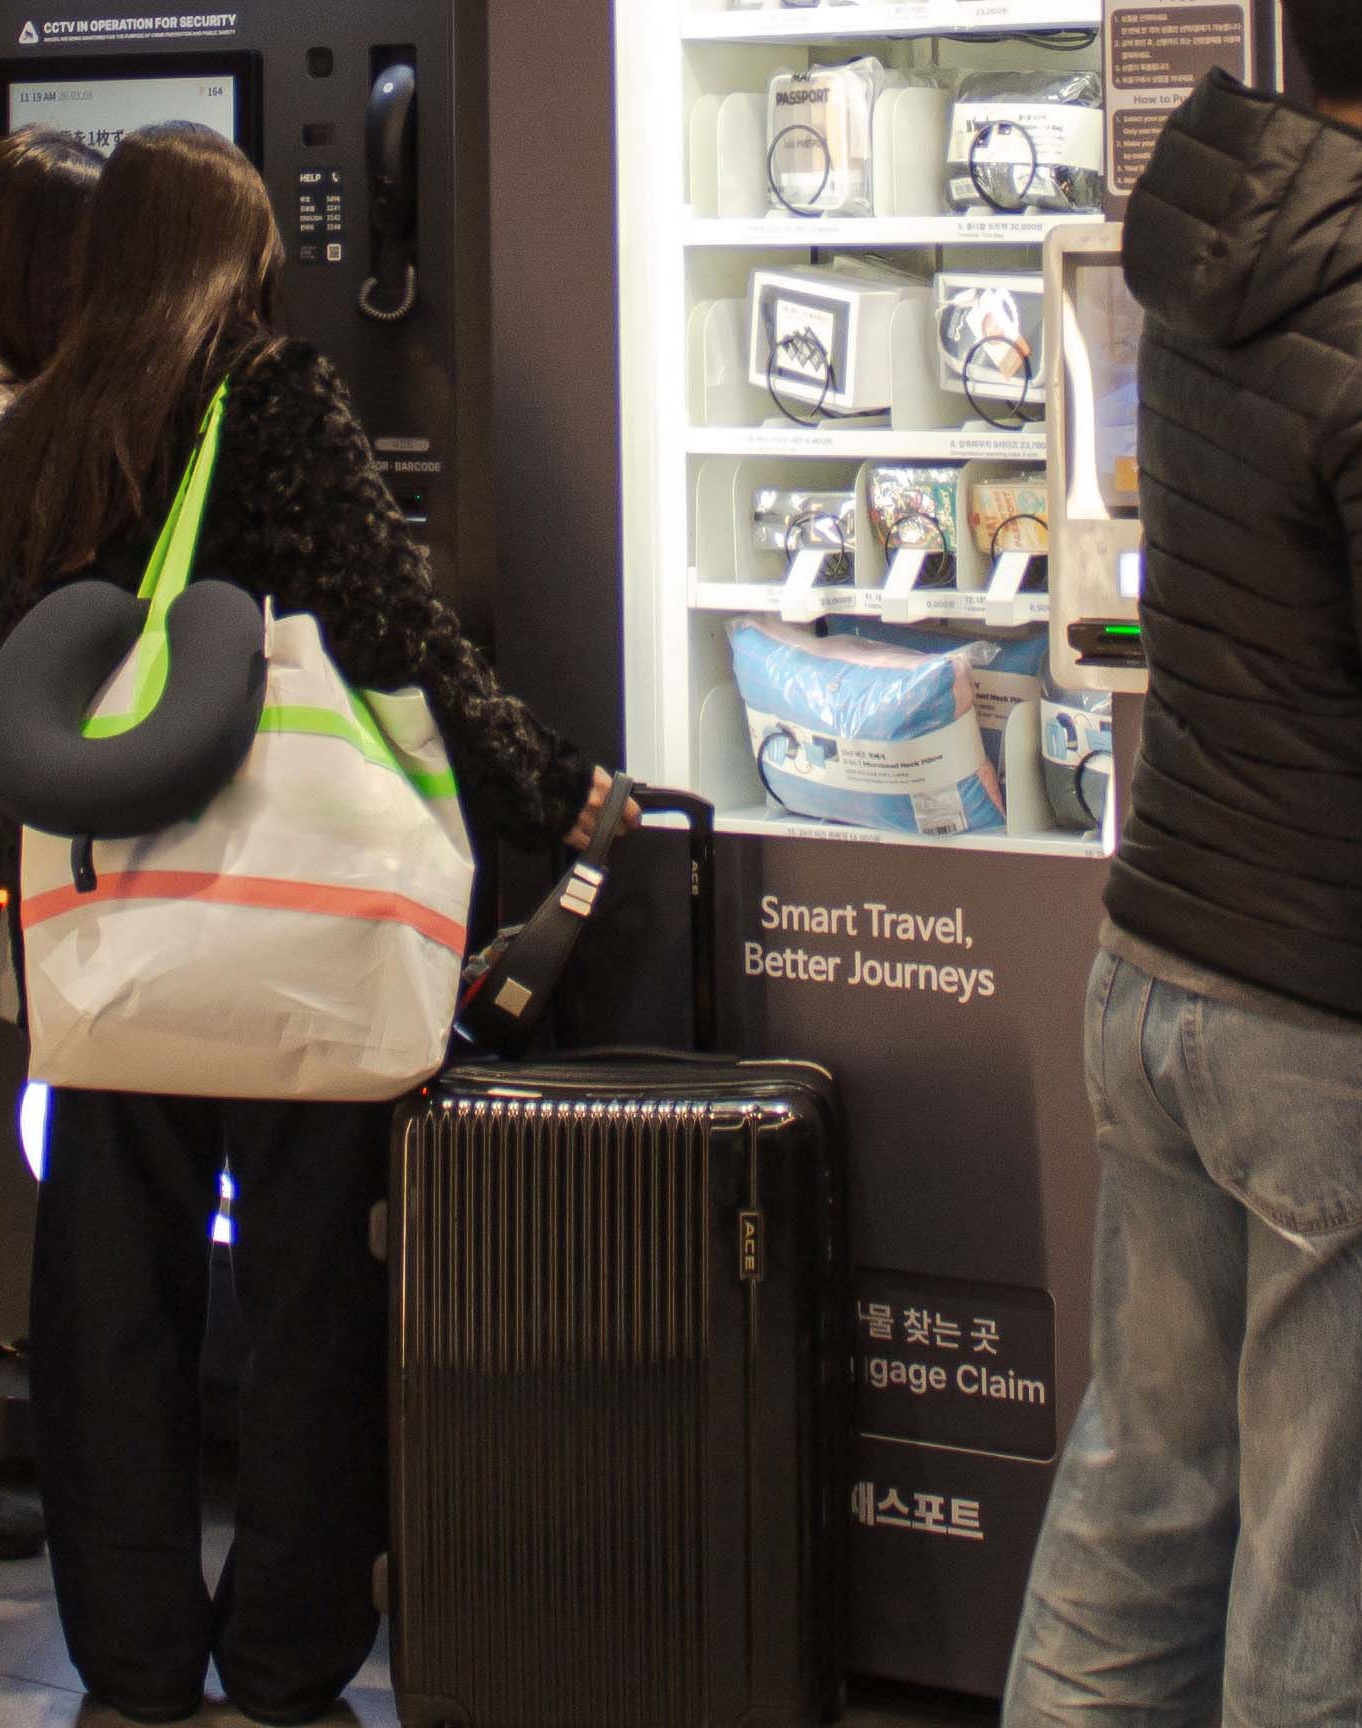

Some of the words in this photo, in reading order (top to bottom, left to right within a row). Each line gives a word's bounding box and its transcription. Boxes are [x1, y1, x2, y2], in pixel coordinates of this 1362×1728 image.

[44, 20, 75, 33] CCTV
[77, 19, 88, 32] IN
[90, 16, 153, 32] OPERATION
[155, 15, 178, 29] FOR
[179, 13, 236, 28] SECURITY
[775, 88, 830, 106] PASSPORT
[1133, 94, 1156, 105] How
[1159, 94, 1170, 104] to
[300, 173, 321, 183] HELP
[394, 461, 441, 472] BARCODE
[760, 894, 857, 939] Smart
[863, 902, 974, 951] Travel,
[743, 942, 840, 985] Better
[848, 951, 995, 1003] Journeys
[744, 1221, 756, 1271] ACE
[857, 1299, 894, 1341] 물
[903, 1307, 962, 1350] 찾는
[970, 1316, 1000, 1355] 곳
[956, 1363, 1045, 1405] Claim
